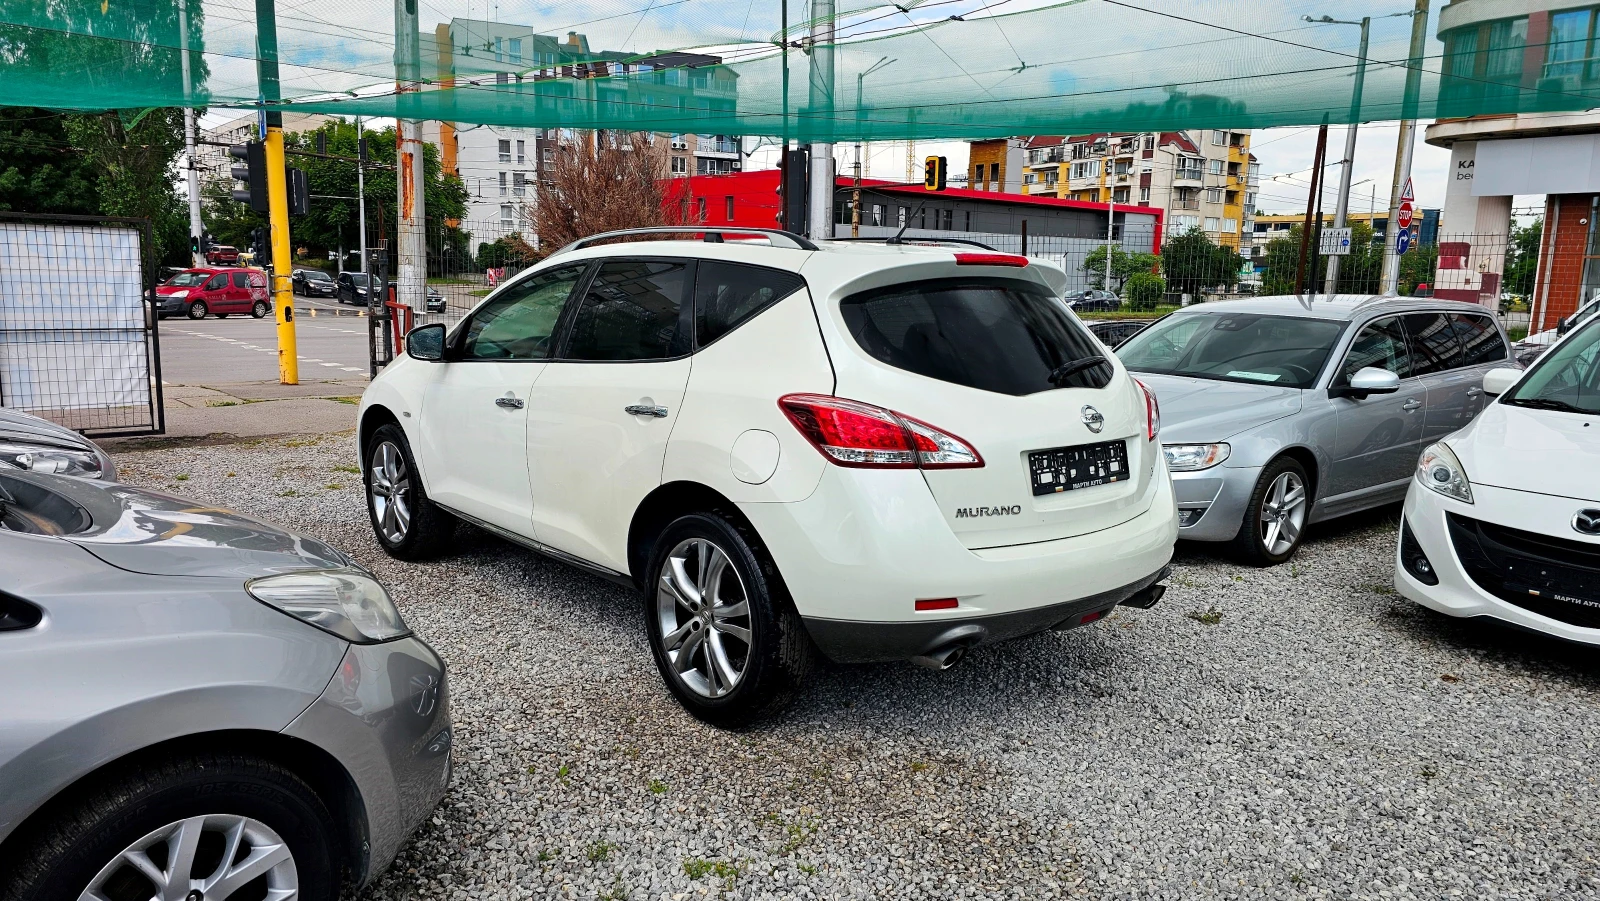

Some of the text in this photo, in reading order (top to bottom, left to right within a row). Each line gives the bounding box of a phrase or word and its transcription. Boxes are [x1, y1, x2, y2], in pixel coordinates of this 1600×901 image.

[1399, 209, 1412, 220] STOP
[1072, 478, 1103, 490] МАРТИ АУТО
[955, 505, 1022, 519] MURANO
[1554, 594, 1582, 604] МАРТИ
